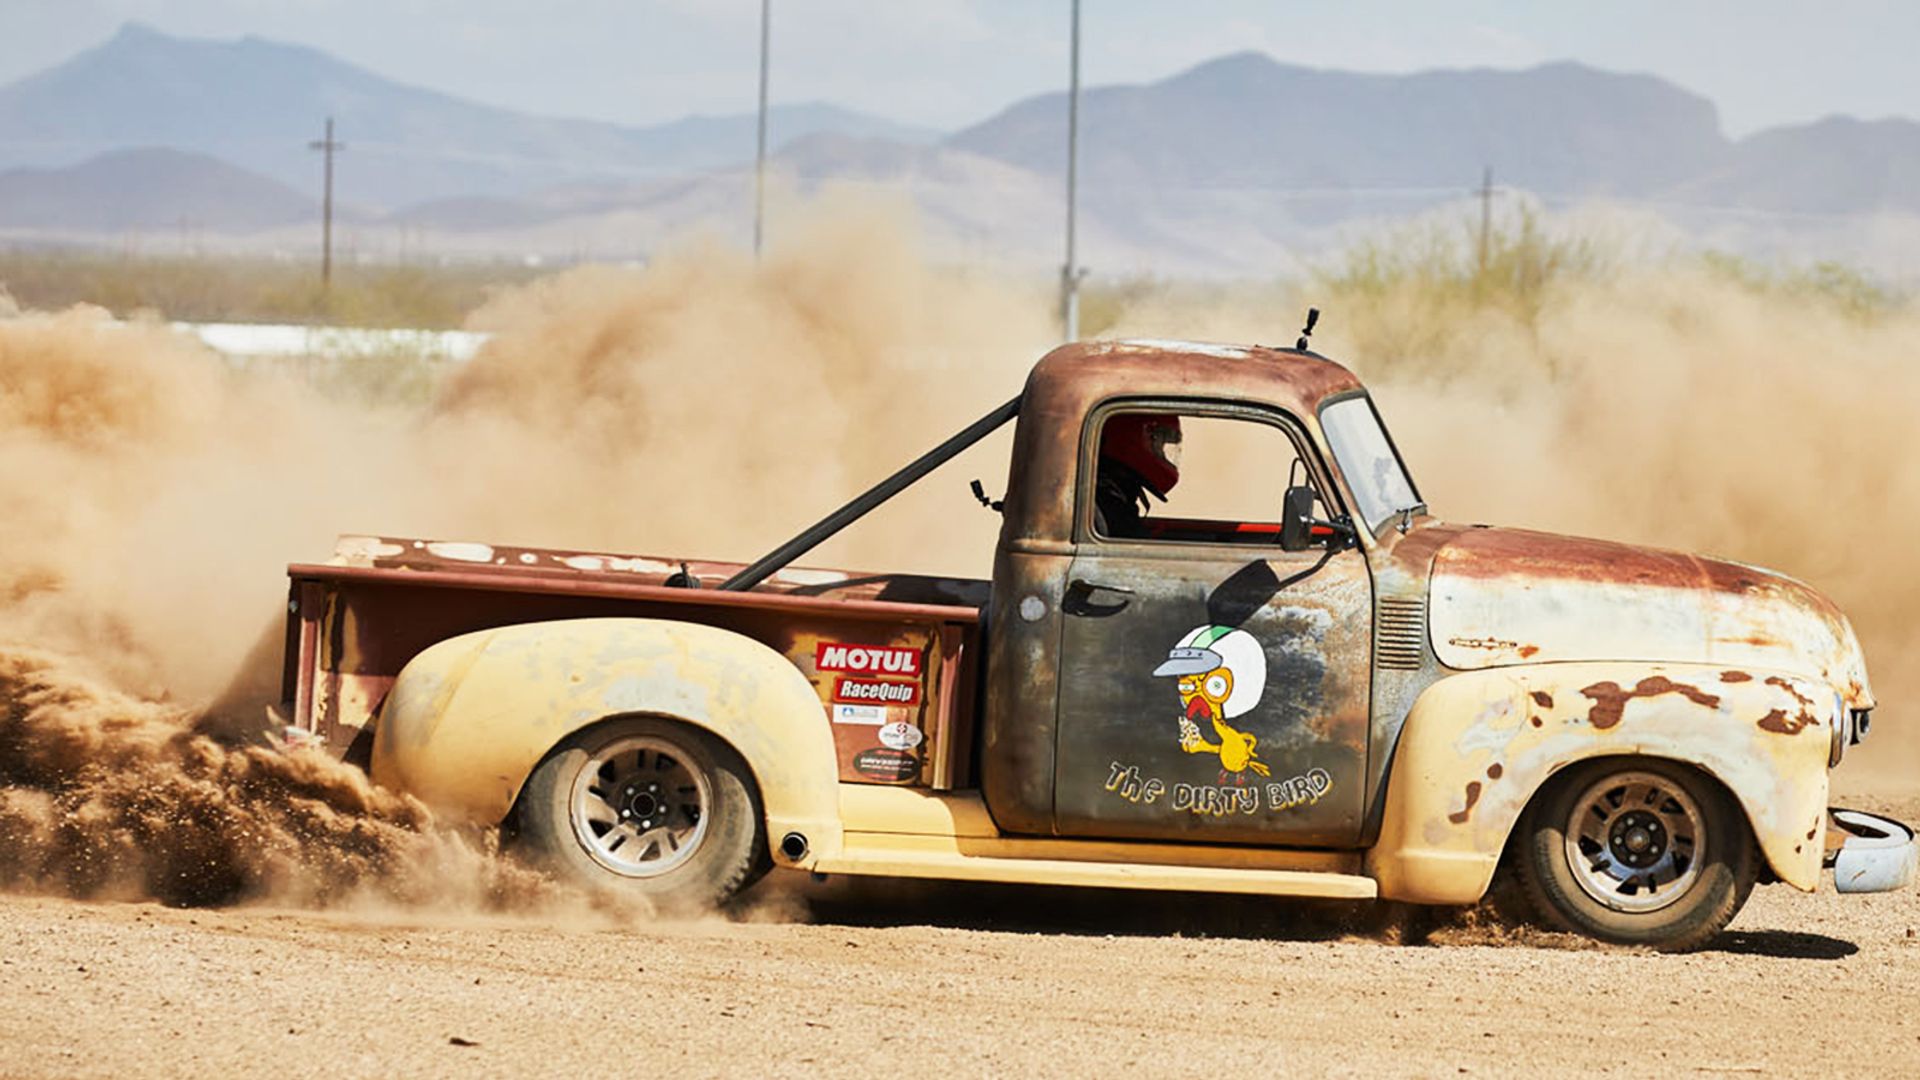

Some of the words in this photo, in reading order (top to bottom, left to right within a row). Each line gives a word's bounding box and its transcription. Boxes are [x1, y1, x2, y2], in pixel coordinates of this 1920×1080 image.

[820, 646, 916, 672] MOTUL
[840, 680, 913, 702] RaceQuip
[1105, 761, 1165, 803] The
[1172, 783, 1259, 817] DIRTY
[1266, 766, 1334, 811] BIRD
